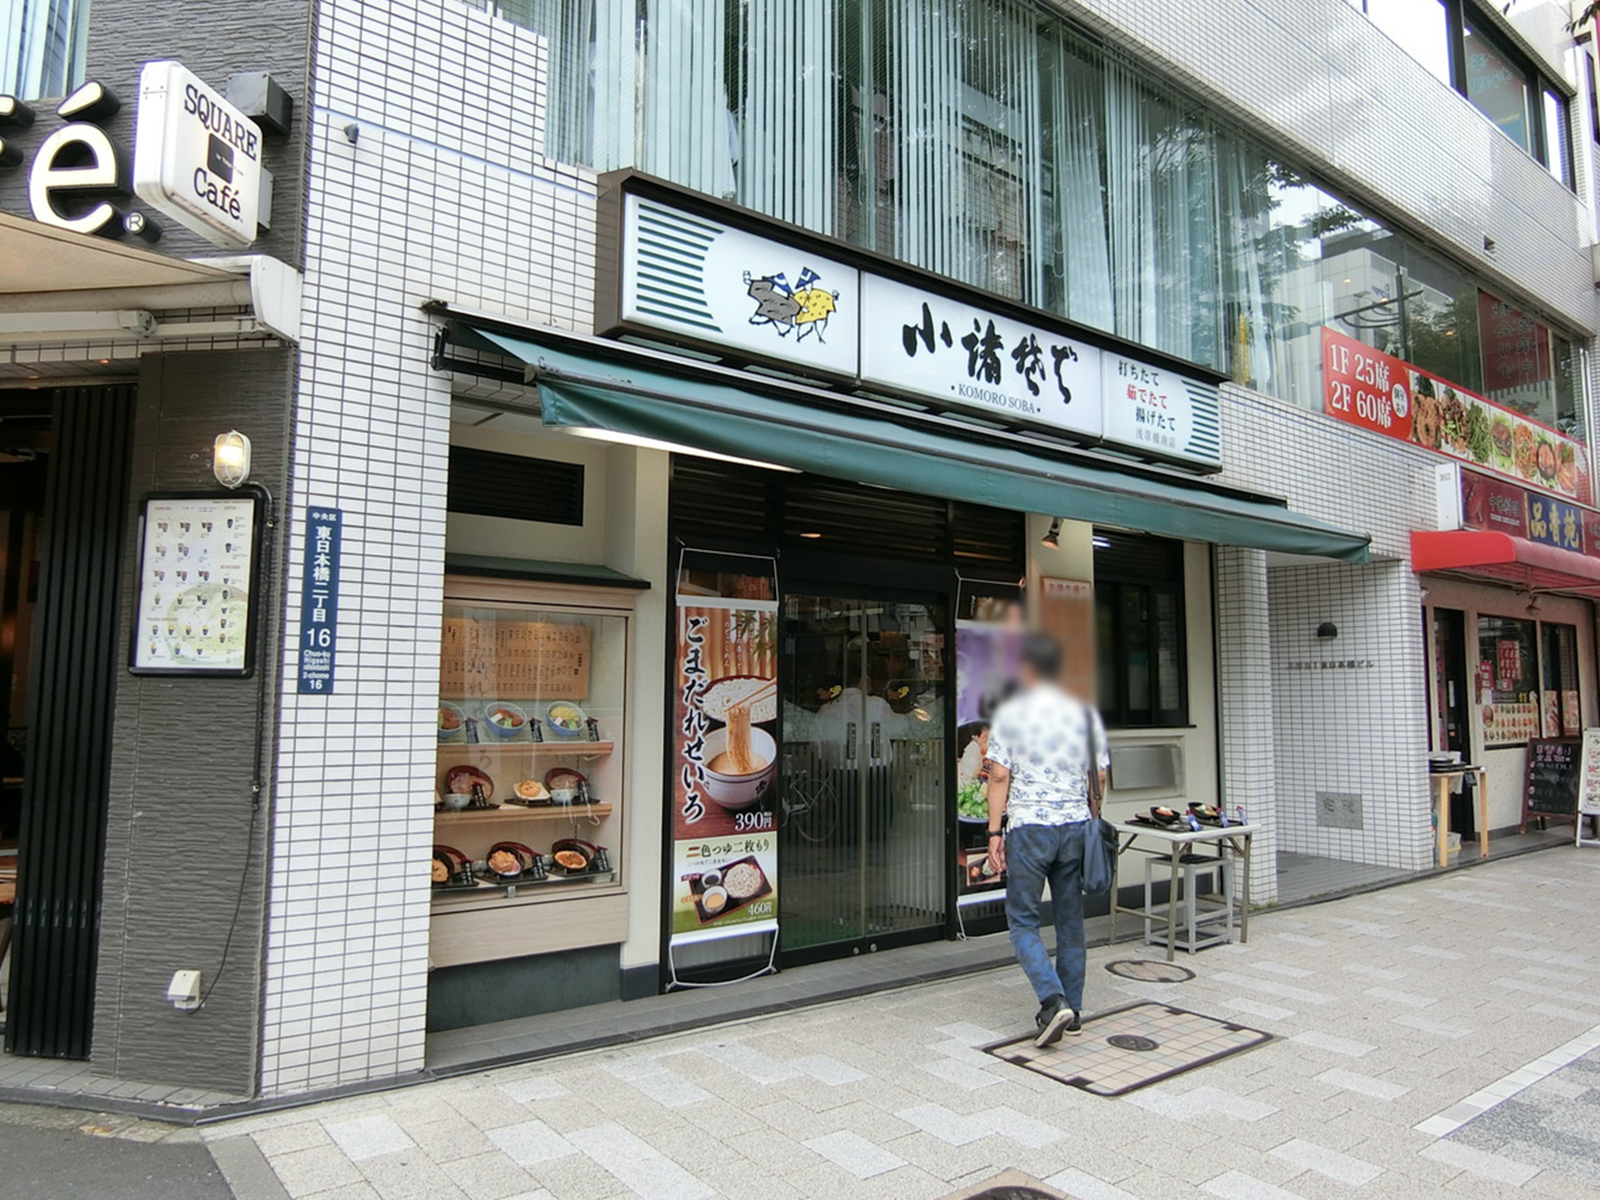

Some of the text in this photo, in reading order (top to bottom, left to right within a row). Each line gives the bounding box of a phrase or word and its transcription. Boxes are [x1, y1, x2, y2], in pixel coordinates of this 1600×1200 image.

[183, 83, 258, 161] SQUARE
[193, 166, 242, 221] Café
[1118, 360, 1159, 387] 打ちたて
[1331, 344, 1390, 393] 1F 25席
[958, 383, 1036, 414] KOMORO SOBA
[1126, 384, 1168, 410] 茹でたて
[1331, 380, 1352, 412] 2F
[1356, 390, 1393, 429] 60席
[1135, 406, 1176, 432] 揚げたて
[312, 511, 338, 521] 中央区
[312, 525, 333, 622] 東日本橋二丁目
[307, 627, 331, 647] 16
[309, 679, 323, 690] 16
[682, 616, 708, 824] ごまだれせいろ
[686, 838, 770, 859] 二色つゆ二枚もり
